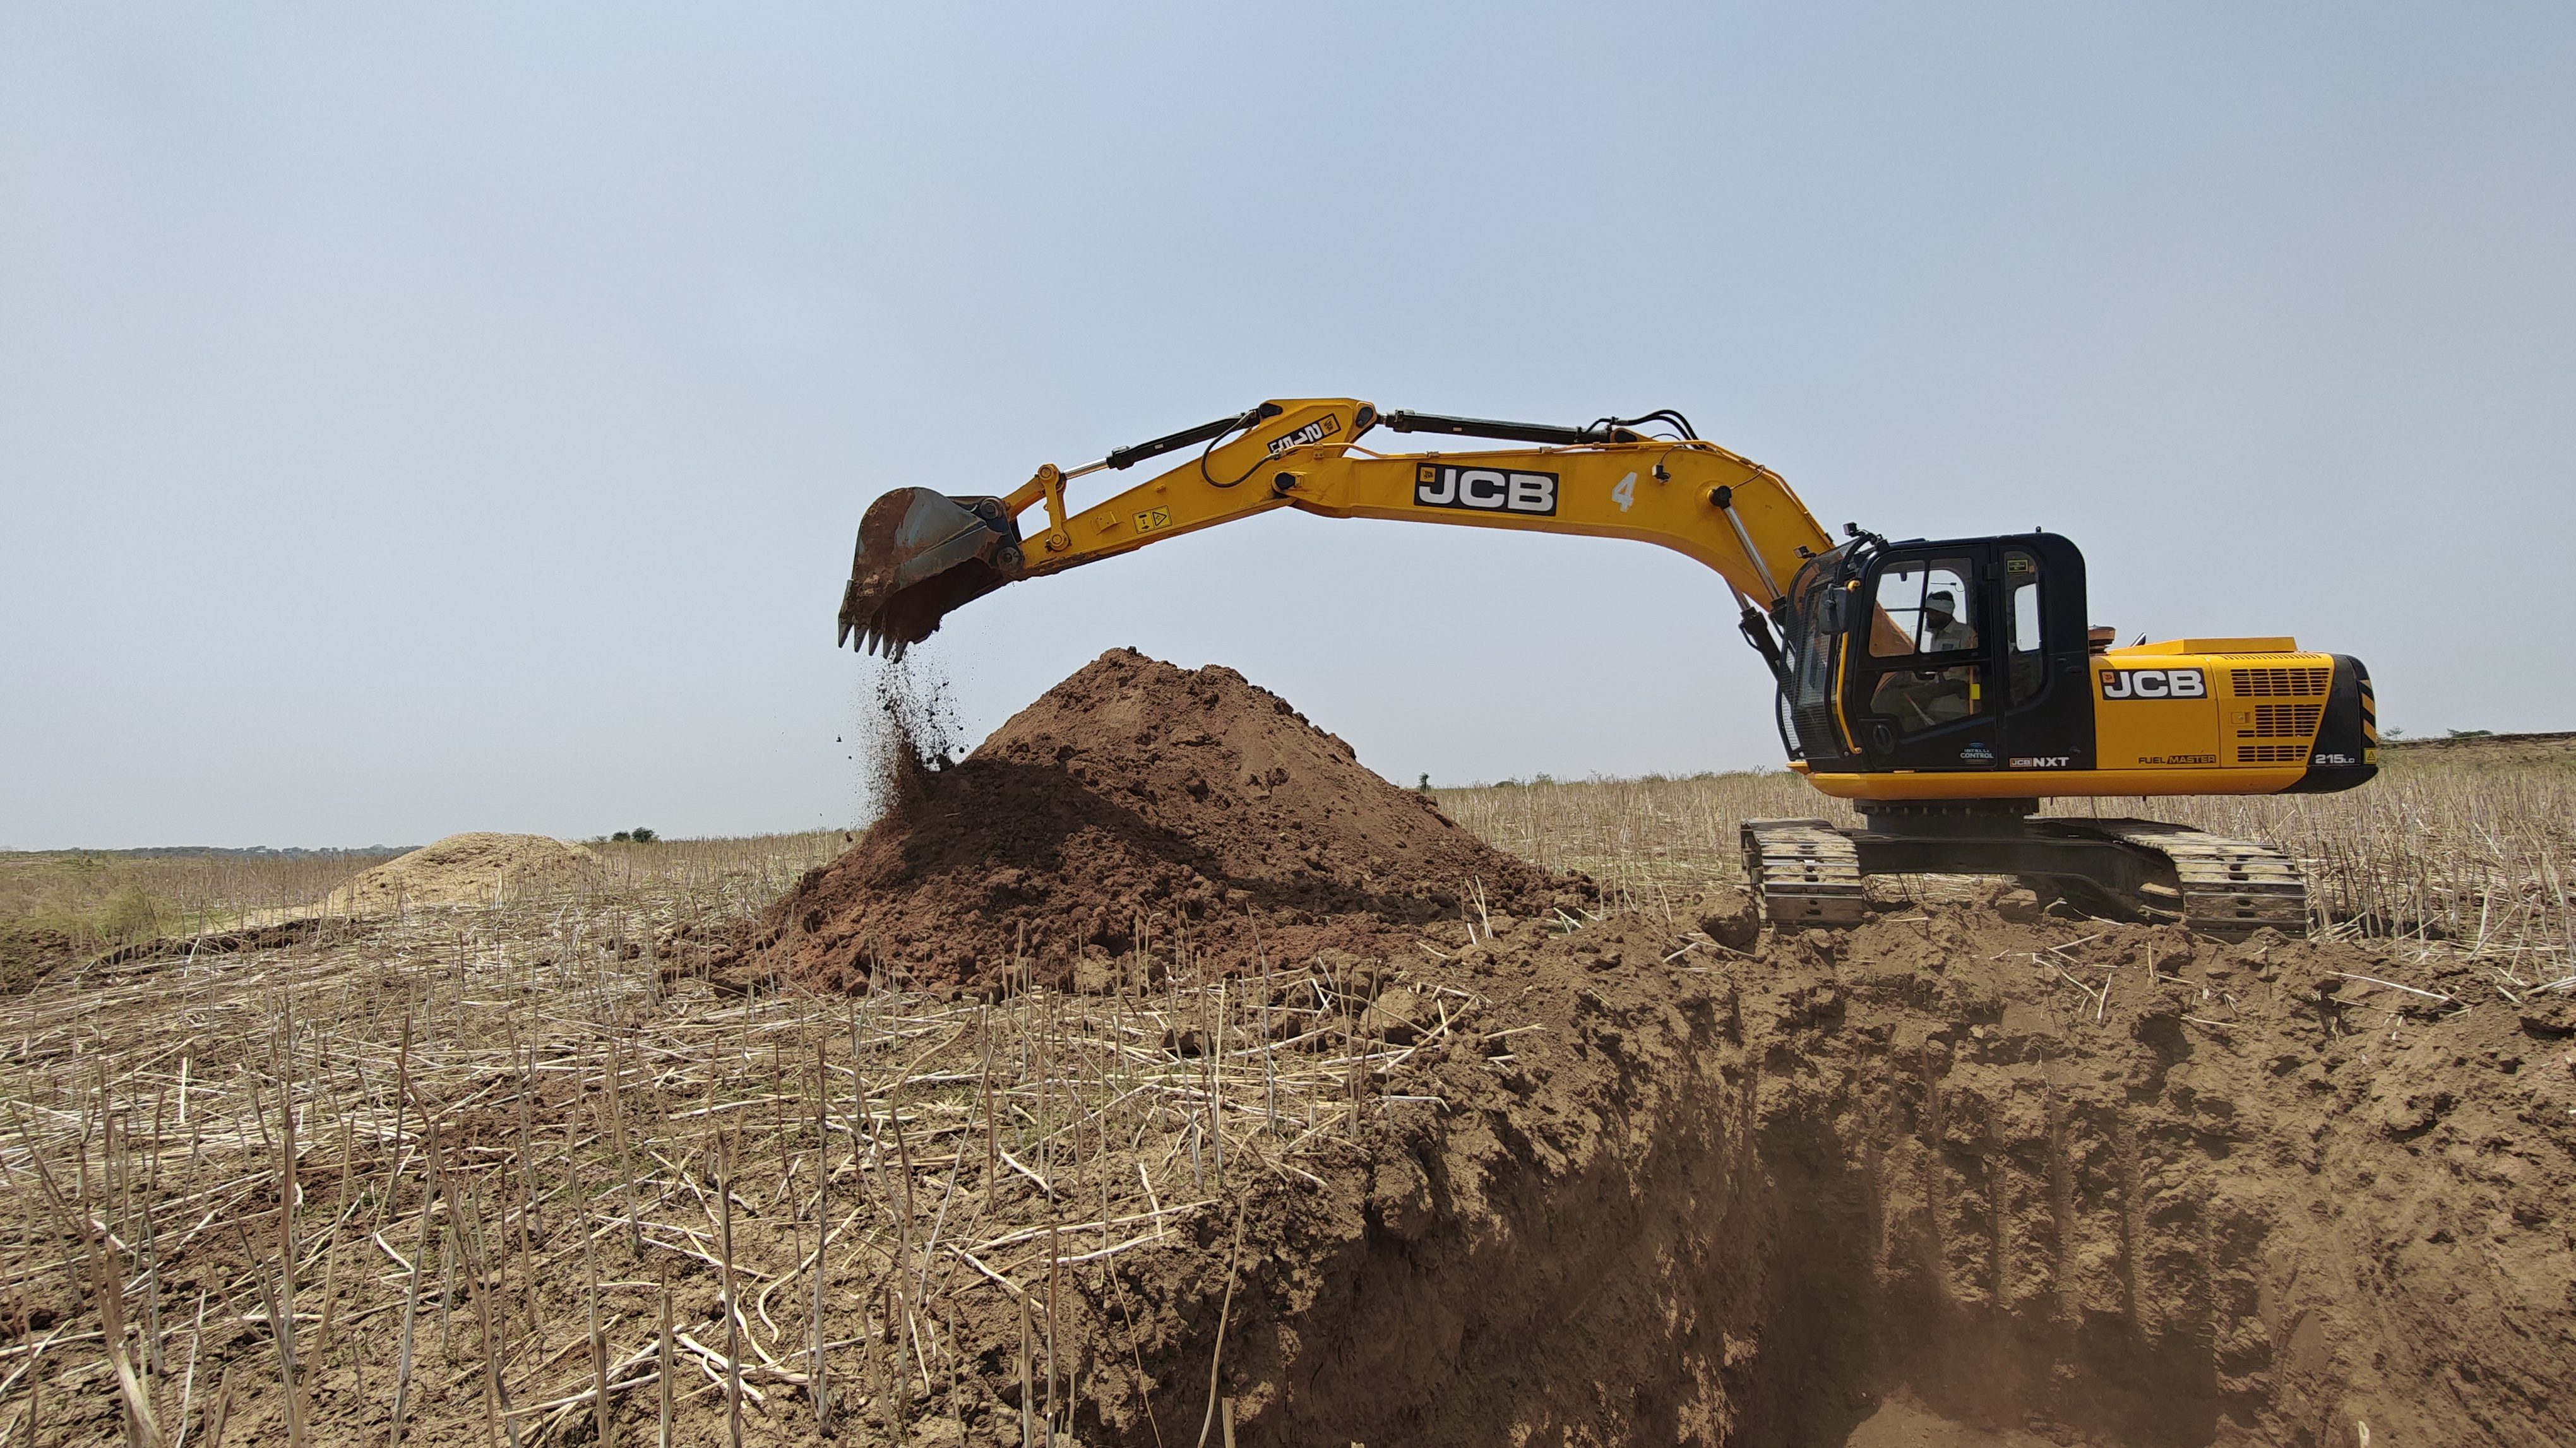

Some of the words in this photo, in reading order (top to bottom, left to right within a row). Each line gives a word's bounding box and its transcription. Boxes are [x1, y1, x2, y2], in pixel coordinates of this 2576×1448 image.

[1419, 468, 1553, 512] JCB
[1611, 471, 1637, 512] 4
[2104, 670, 2204, 697] JCB
[2033, 757, 2070, 767] NXT
[2169, 756, 2215, 764] MASTER
